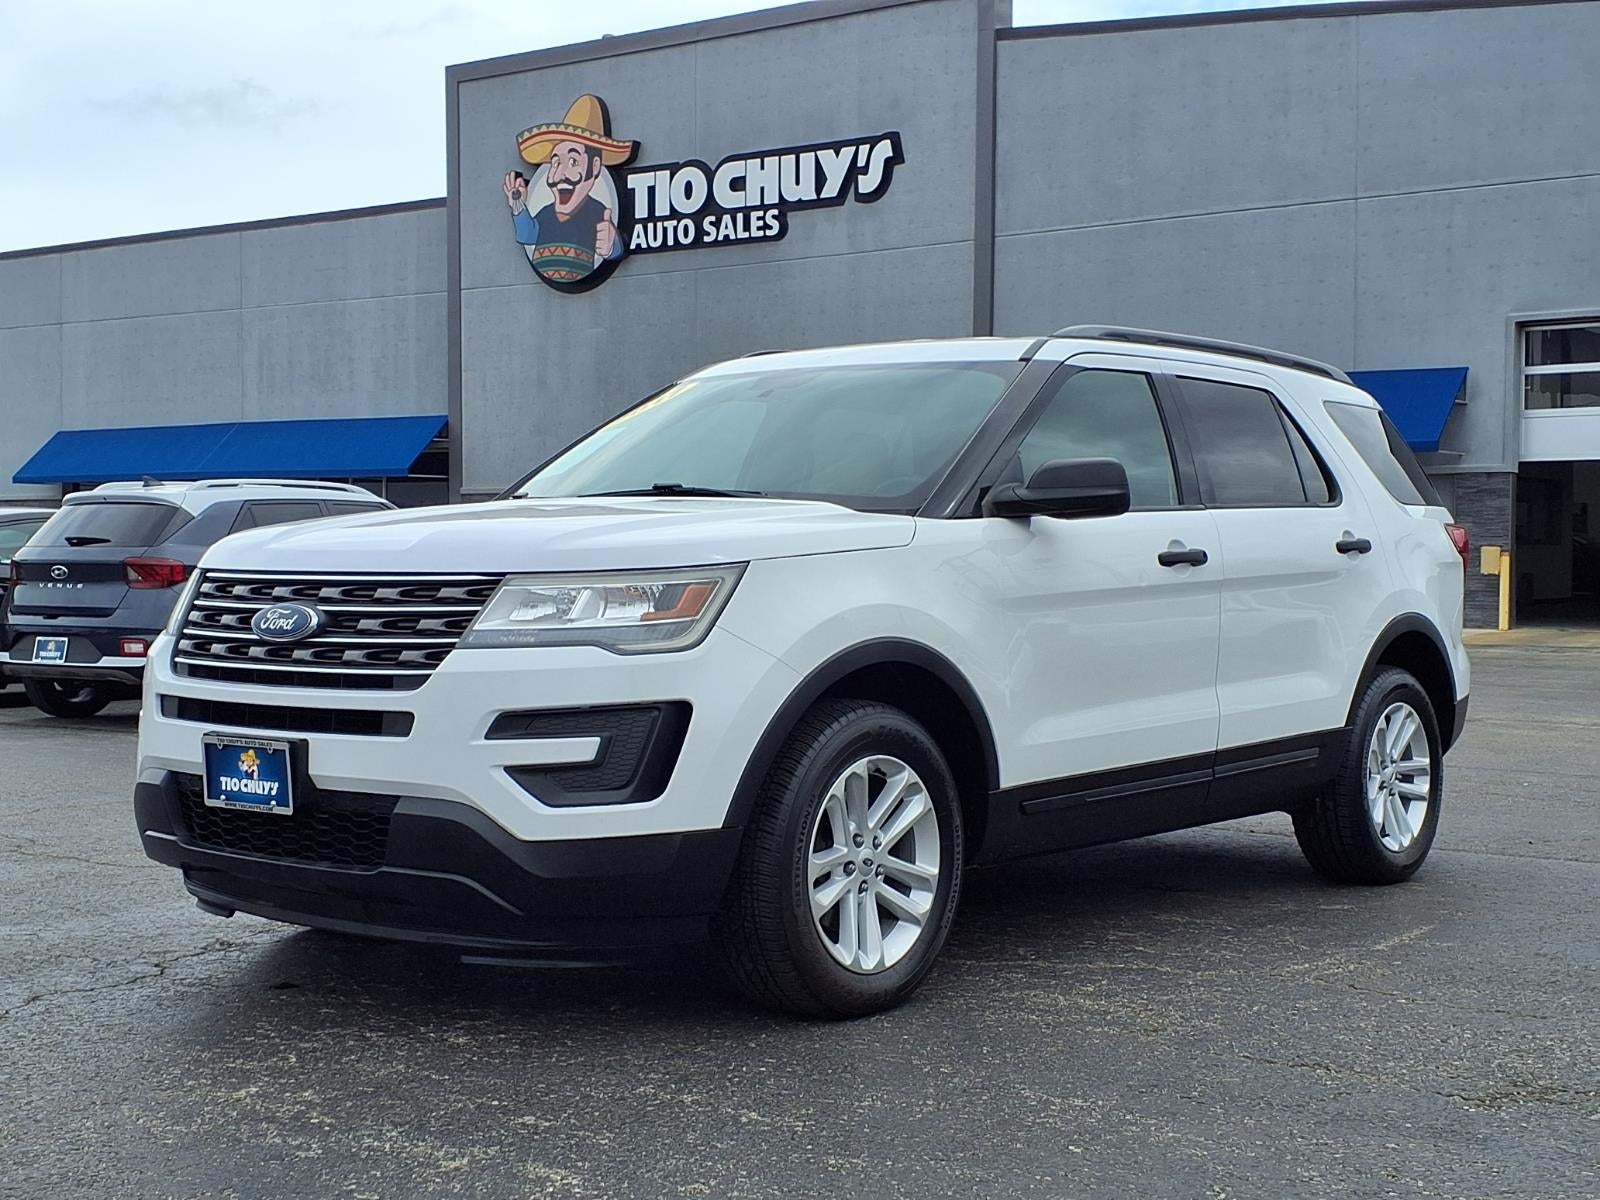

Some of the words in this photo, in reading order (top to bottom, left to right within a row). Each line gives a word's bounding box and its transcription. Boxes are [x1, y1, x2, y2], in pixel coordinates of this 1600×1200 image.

[627, 166, 708, 219] TIO
[712, 138, 894, 209] CHUY'S
[629, 218, 696, 250] AUTO
[703, 209, 780, 243] SALES
[260, 608, 299, 631] Ford
[220, 777, 239, 791] TIO
[240, 779, 279, 796] CHUY'S
